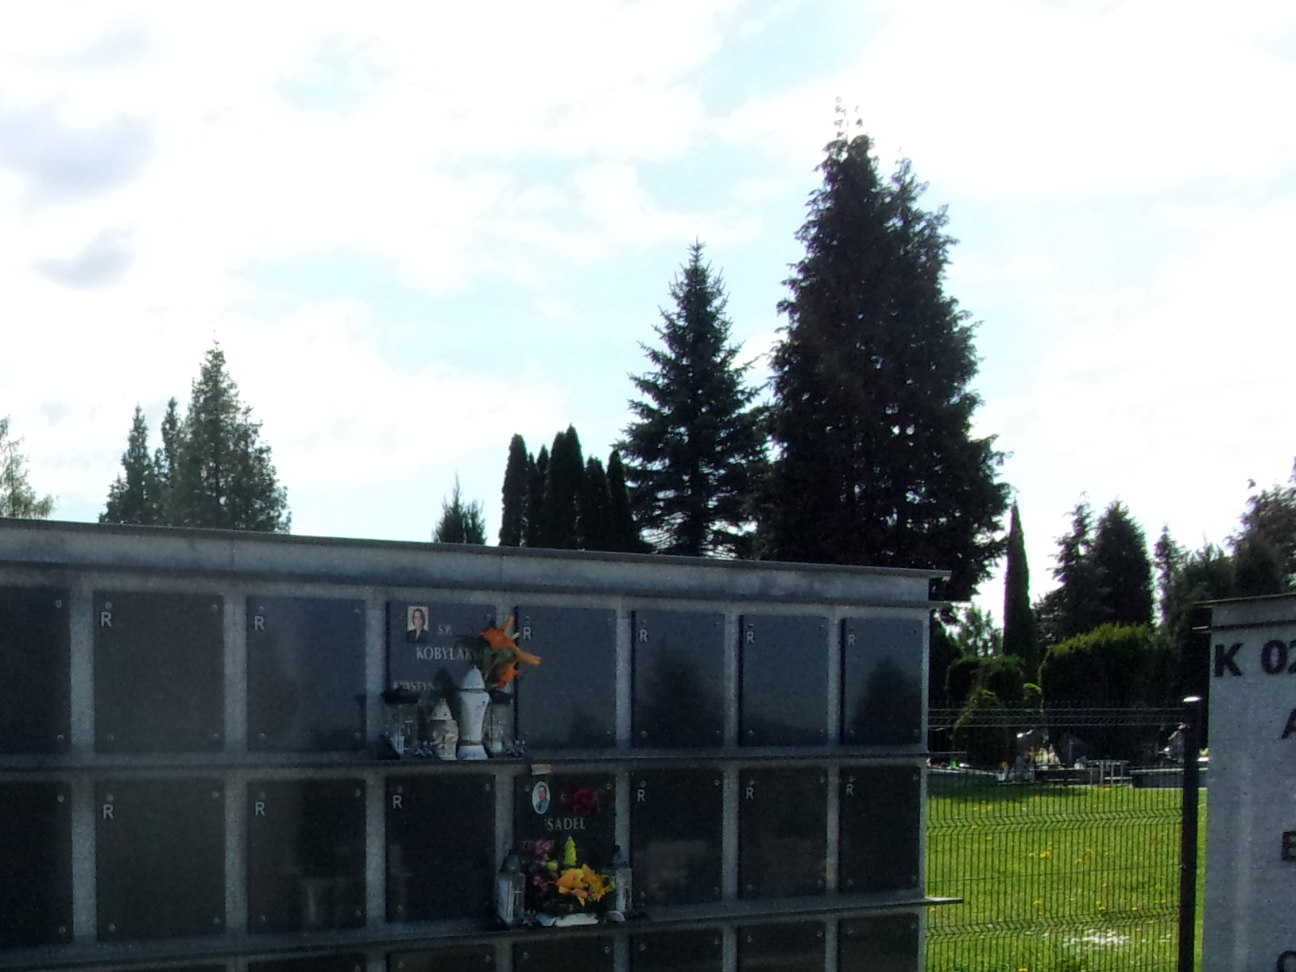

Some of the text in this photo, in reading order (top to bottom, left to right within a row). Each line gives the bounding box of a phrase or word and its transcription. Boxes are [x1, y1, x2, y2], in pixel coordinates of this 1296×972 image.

[100, 611, 113, 628] R
[254, 615, 265, 631] R
[522, 626, 533, 641] R
[639, 628, 648, 643] R
[746, 631, 755, 645] R
[847, 633, 857, 647] R
[1214, 643, 1243, 677] K
[637, 788, 647, 804] R
[745, 786, 754, 801] R
[845, 783, 854, 797] R
[255, 801, 265, 817] R
[392, 794, 403, 810] R
[102, 803, 114, 820] R
